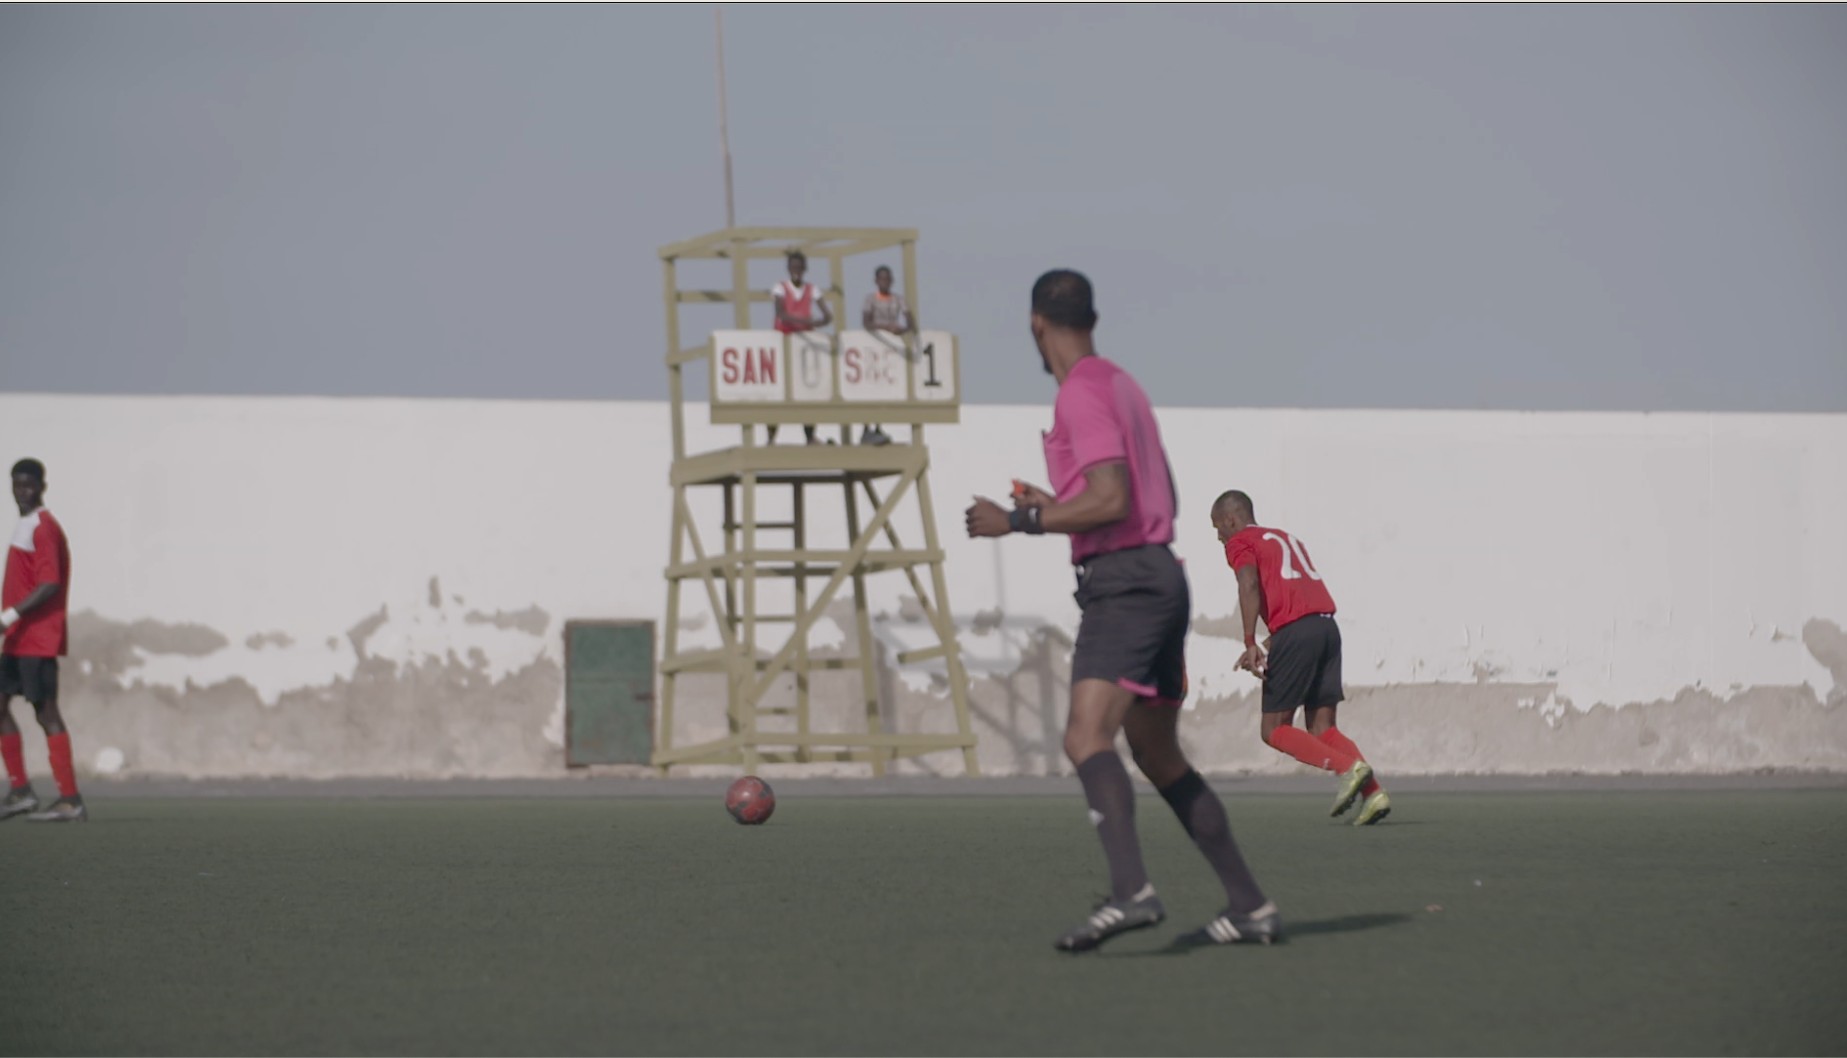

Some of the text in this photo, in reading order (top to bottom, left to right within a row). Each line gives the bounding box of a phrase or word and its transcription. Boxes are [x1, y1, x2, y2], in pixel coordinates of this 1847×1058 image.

[722, 347, 778, 385] SAN
[923, 342, 942, 387] 1
[1262, 531, 1322, 580] 20
